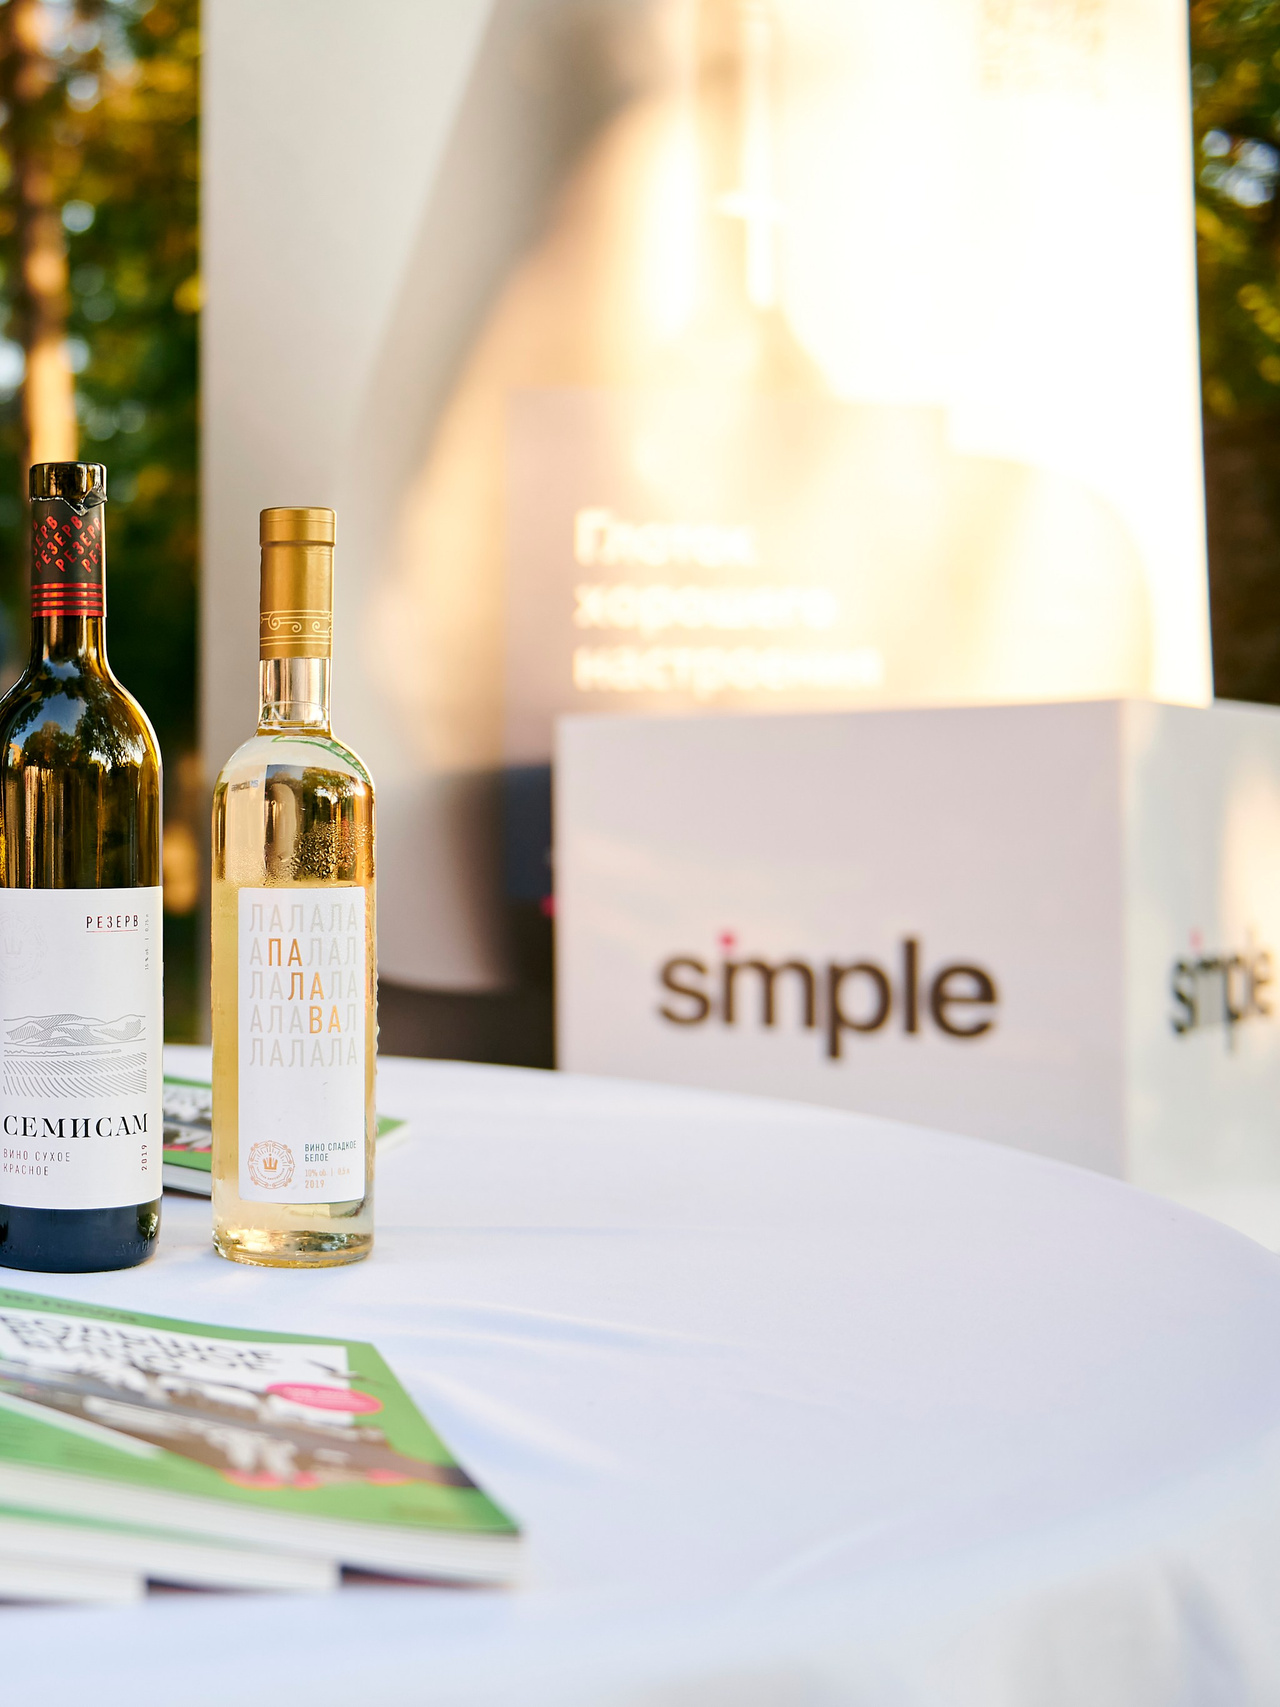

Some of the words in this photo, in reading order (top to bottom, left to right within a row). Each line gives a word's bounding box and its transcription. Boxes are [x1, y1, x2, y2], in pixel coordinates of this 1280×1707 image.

[86, 914, 139, 929] РЕЗЕРВ
[659, 936, 996, 1060] simple
[3, 1112, 148, 1138] СЕМИСАМ
[304, 1143, 325, 1152] ВИНО
[328, 1140, 356, 1151] СЛАДКОЕ
[3, 1148, 29, 1161] ВИНО
[35, 1150, 70, 1162] СУХОЕ
[304, 1153, 329, 1162] БЕЛОЕ
[3, 1163, 49, 1176] КРАСНОЕ
[304, 1180, 325, 1188] 2019
